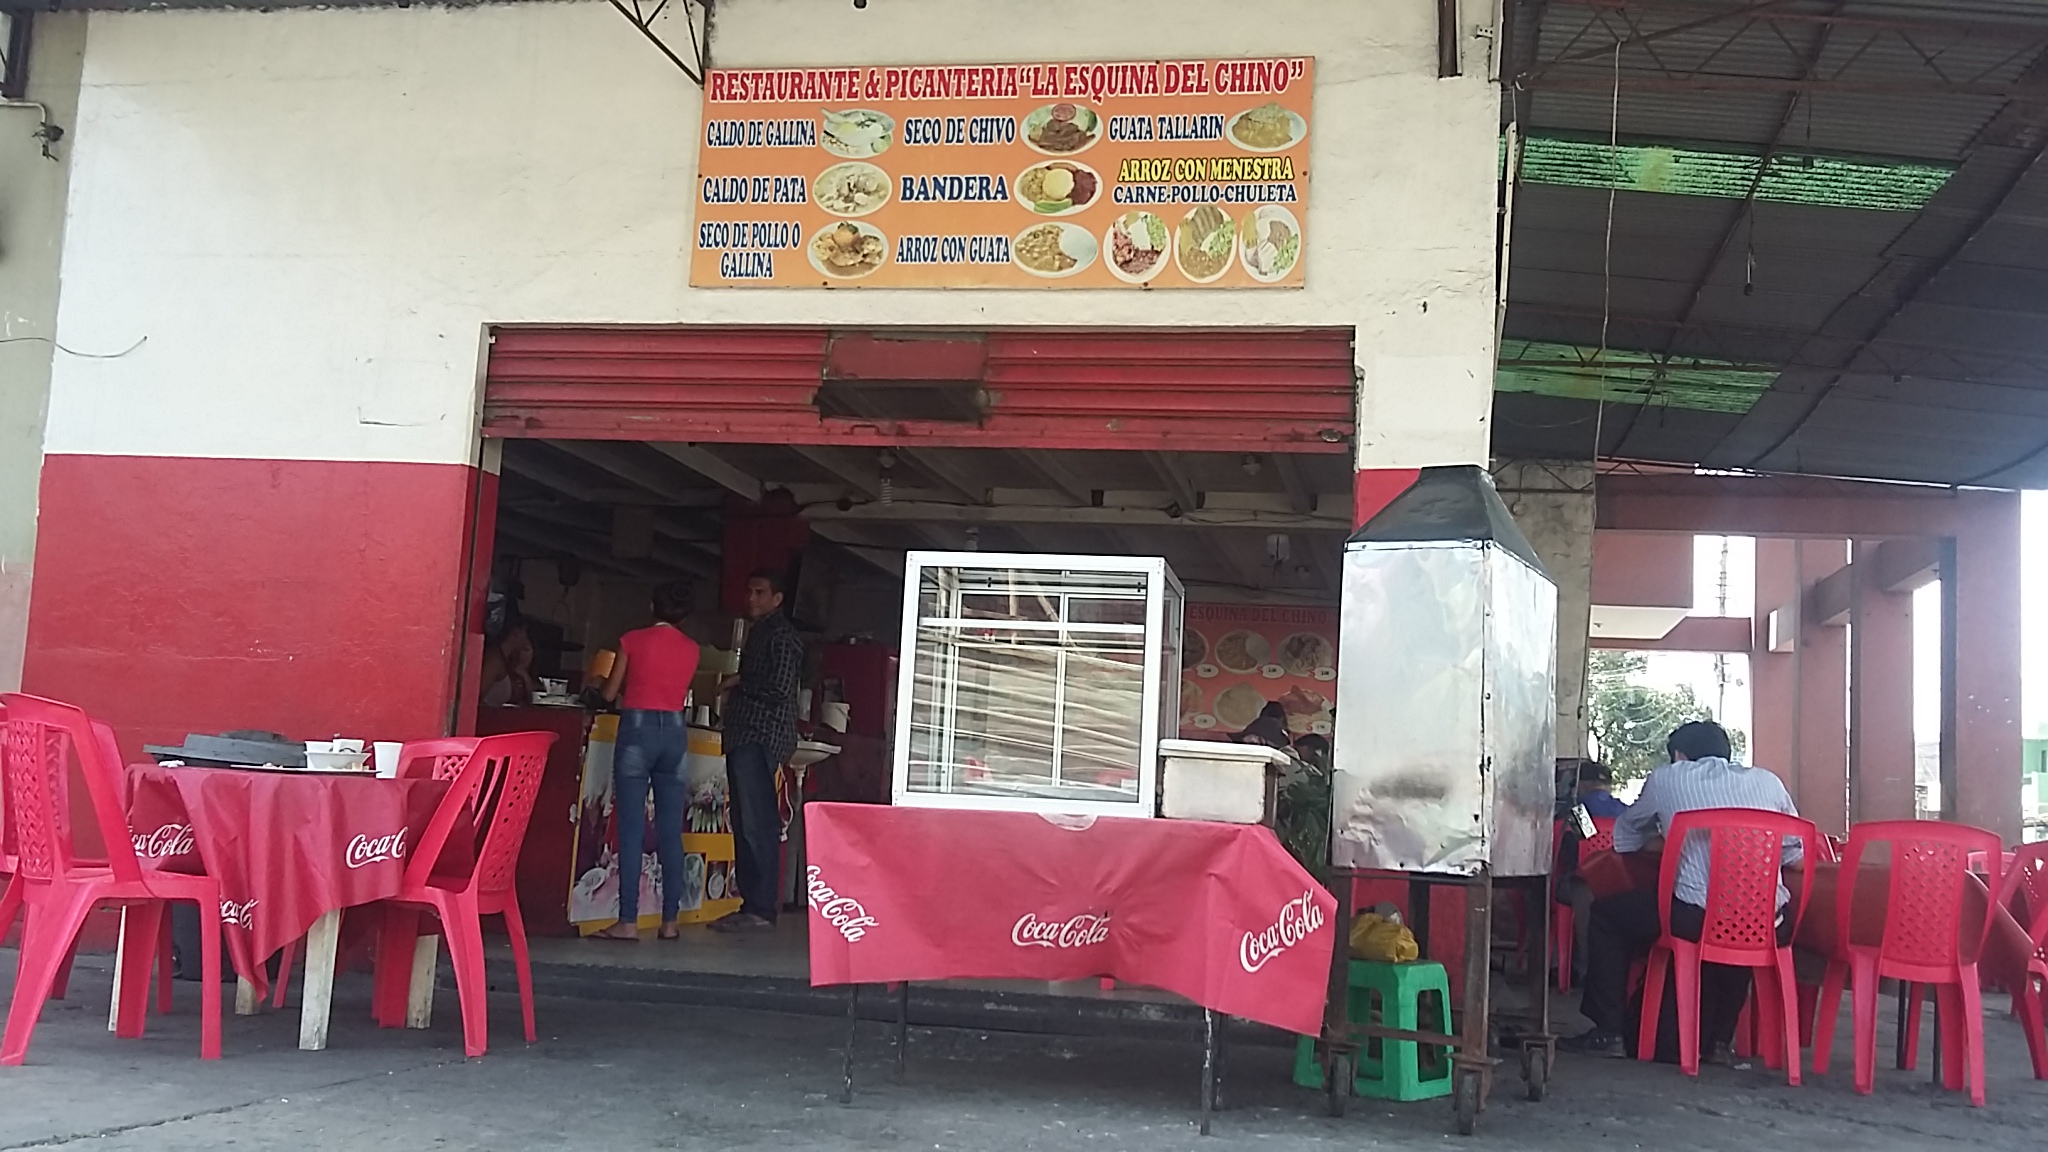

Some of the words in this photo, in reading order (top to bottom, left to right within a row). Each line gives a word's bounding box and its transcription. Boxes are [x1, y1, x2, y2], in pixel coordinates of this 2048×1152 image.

[709, 70, 861, 102] RESTAURANTE
[864, 69, 881, 99] &
[885, 66, 1018, 99] PICANTERIA
[1063, 62, 1159, 104] ESQUINA
[1163, 62, 1210, 94] DEL
[707, 120, 745, 146] CALDO
[747, 120, 763, 146] DE
[764, 120, 817, 146] GALLINA
[904, 118, 942, 144] SECO
[945, 118, 966, 144] DE
[968, 117, 1017, 144] CHIVO
[1109, 117, 1153, 140] GUATA
[1157, 115, 1225, 140] TALLARIN
[1118, 159, 1171, 182] ARROZ
[1174, 159, 1208, 181] CON
[1210, 157, 1294, 181] MENESTRA
[703, 177, 748, 203] CALDO
[751, 177, 770, 203] DE
[772, 177, 807, 203] PATA
[900, 176, 1010, 202] BANDERA
[698, 222, 730, 248] SECO
[731, 222, 748, 248] DE
[750, 222, 789, 248] POLLO
[791, 223, 801, 248] O
[896, 237, 939, 263] ARROZ
[941, 237, 967, 263] CON
[969, 237, 1011, 263] GUATA
[720, 252, 774, 278] GALLINA
[1188, 605, 1247, 623] ESQUINA
[1281, 609, 1327, 625] CHINO
[1011, 911, 1110, 950] Coca-Cola
[1239, 888, 1325, 974] Coca-Cola
